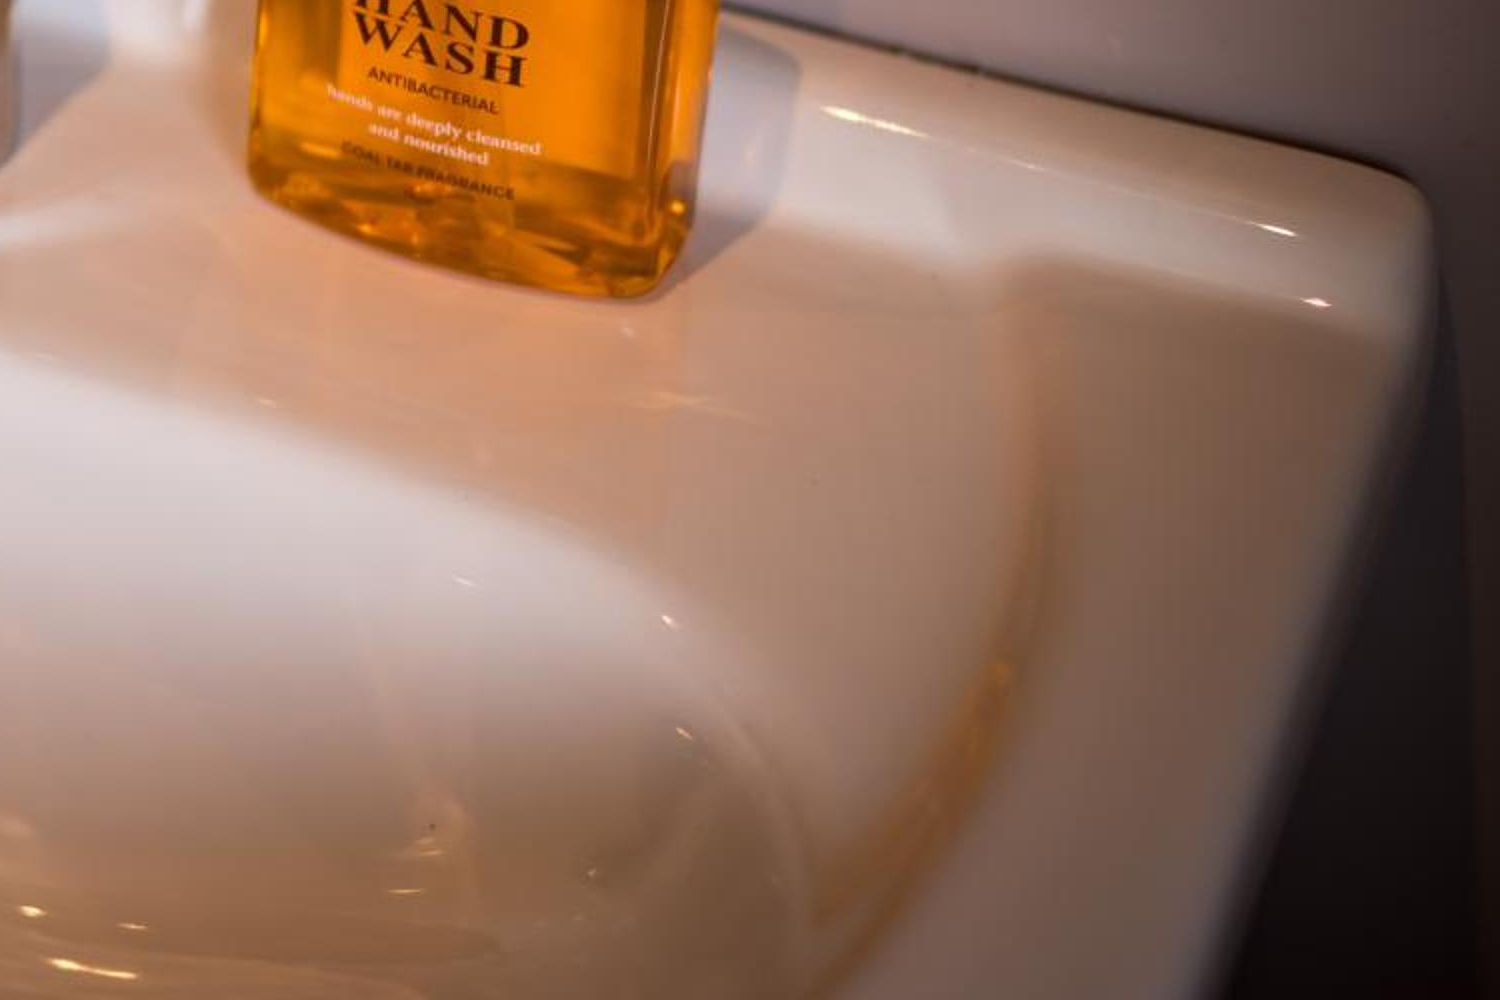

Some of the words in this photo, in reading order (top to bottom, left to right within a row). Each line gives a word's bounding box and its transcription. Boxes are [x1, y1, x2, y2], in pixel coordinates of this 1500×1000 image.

[351, 7, 529, 88] WASH
[327, 82, 373, 112] hands
[377, 104, 402, 121] are
[405, 112, 462, 142] deeply
[466, 129, 542, 156] cleansed
[367, 66, 500, 115] ANTIBACTERIAL
[367, 122, 399, 142] and
[403, 134, 489, 167] nourished
